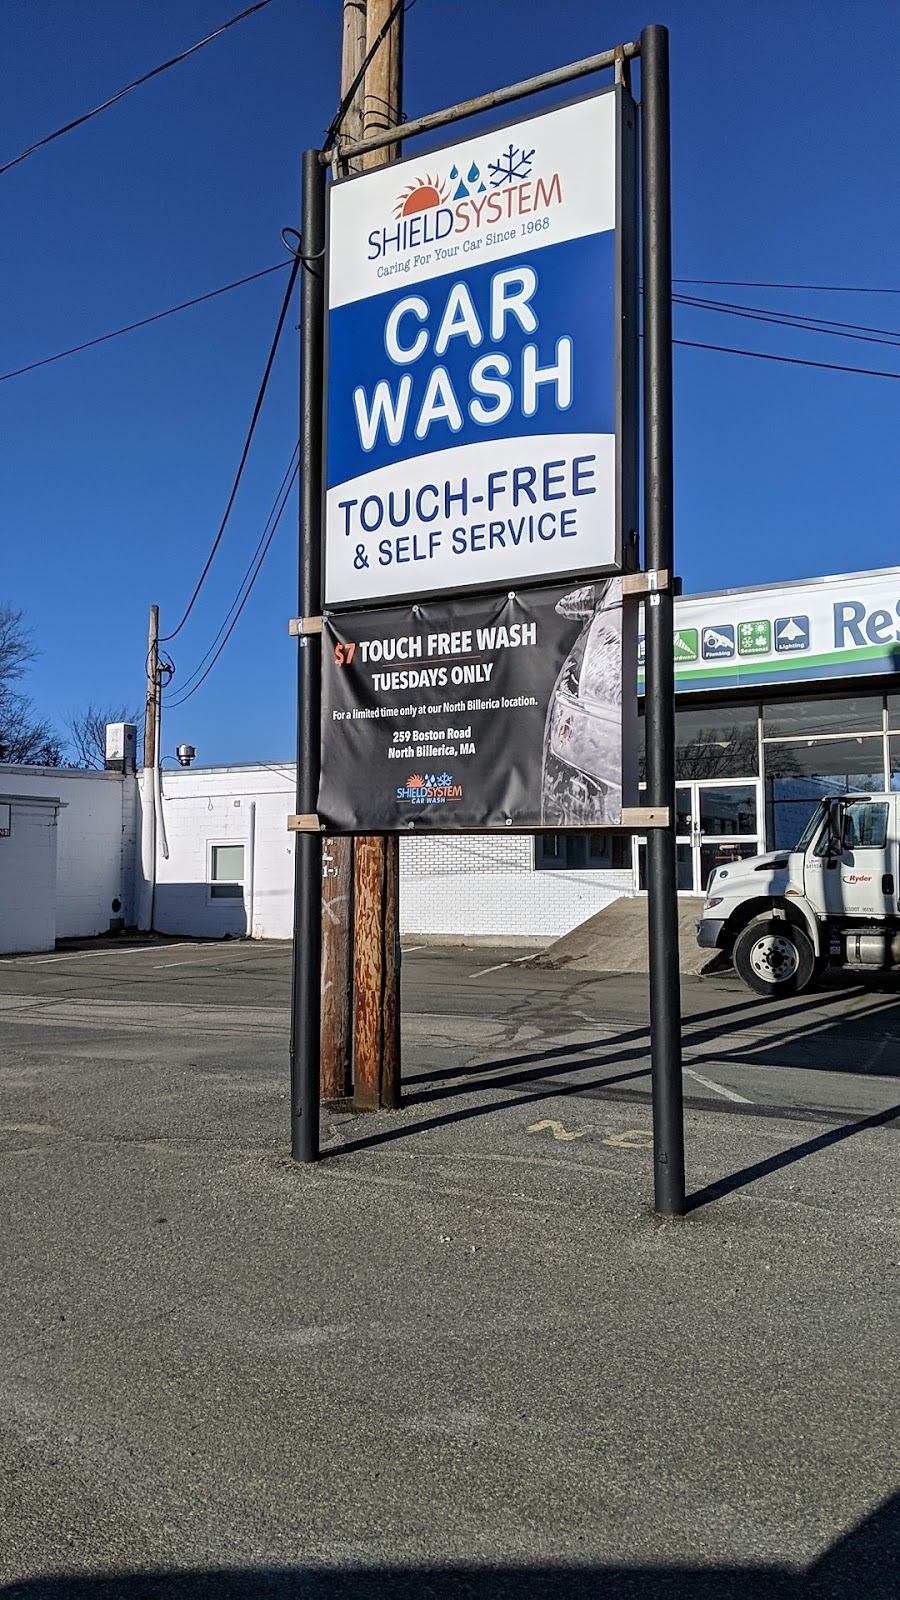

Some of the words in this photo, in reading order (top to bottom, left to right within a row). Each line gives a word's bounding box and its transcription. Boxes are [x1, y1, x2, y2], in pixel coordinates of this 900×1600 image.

[376, 259, 411, 278] Caring
[413, 254, 431, 268] For
[434, 245, 460, 261] Your
[462, 238, 483, 253] Car
[486, 228, 516, 246] Since
[520, 217, 550, 236] 1968
[384, 266, 538, 364] CAR
[353, 336, 573, 451] WASH
[338, 454, 597, 537] TOUCH-FREE
[352, 543, 370, 570] &
[378, 531, 443, 566] SELF
[451, 508, 578, 555] SERVICE
[833, 600, 900, 649] Re
[334, 642, 356, 667] $7
[359, 635, 422, 663] TOUCH
[427, 630, 473, 657] FREE
[476, 622, 537, 651] WASH
[706, 650, 731, 658] Plumbing
[740, 646, 768, 654] Seasonal
[779, 642, 805, 650] Lighting
[372, 666, 448, 692] TUESDAYS
[451, 662, 494, 685] ONLY
[332, 710, 346, 720] For
[352, 707, 380, 719] limited
[380, 706, 399, 717] time
[400, 704, 417, 718] only
[418, 705, 427, 714] at
[428, 704, 442, 714] our
[443, 700, 466, 713] North
[467, 697, 500, 711] Billerica
[501, 695, 539, 708] location.
[388, 746, 414, 759] North
[416, 744, 458, 757] Billerica,
[459, 742, 476, 755] MA
[392, 730, 411, 743] 259
[412, 729, 445, 742] Boston
[447, 726, 472, 740] Road
